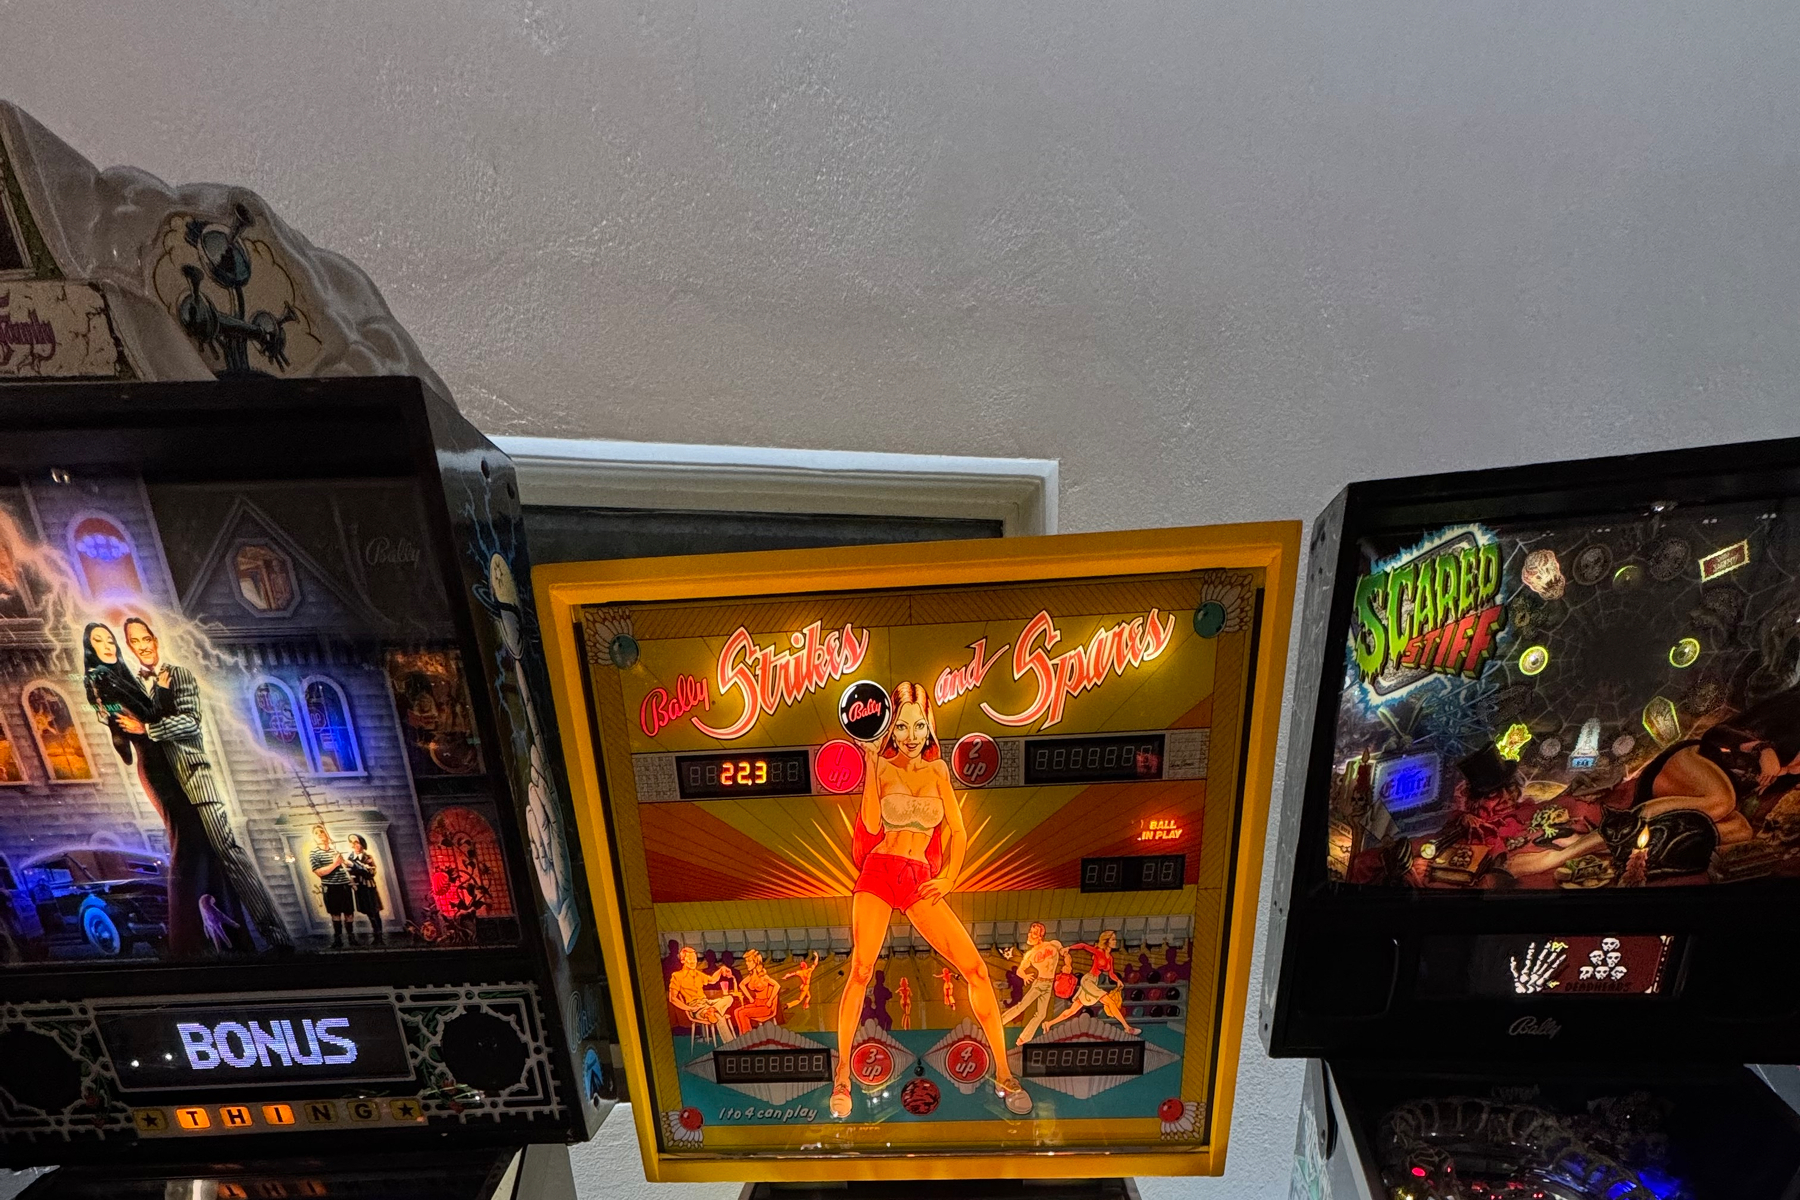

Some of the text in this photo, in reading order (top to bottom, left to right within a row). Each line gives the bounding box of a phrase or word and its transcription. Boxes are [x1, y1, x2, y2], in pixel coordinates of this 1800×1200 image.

[1354, 542, 1502, 684] SCARED
[1400, 604, 1508, 680] STIFF
[640, 608, 1176, 740] Bally Strikes and Spares
[848, 698, 882, 723] Bally
[968, 739, 983, 759] 2
[828, 768, 850, 789] up
[963, 763, 986, 782] up
[1142, 829, 1182, 840] IN PLAY
[1150, 820, 1176, 830] BALL
[1565, 981, 1629, 992] DEADHEADS
[1509, 1016, 1562, 1039] Bally
[177, 1018, 358, 1070] BONUS
[961, 1047, 972, 1060] 4
[866, 1048, 877, 1063] 3
[862, 1063, 882, 1081] up
[955, 1061, 976, 1080] up
[726, 1109, 742, 1120] to
[744, 1107, 755, 1119] 4
[757, 1110, 782, 1120] can
[783, 1105, 818, 1122] play
